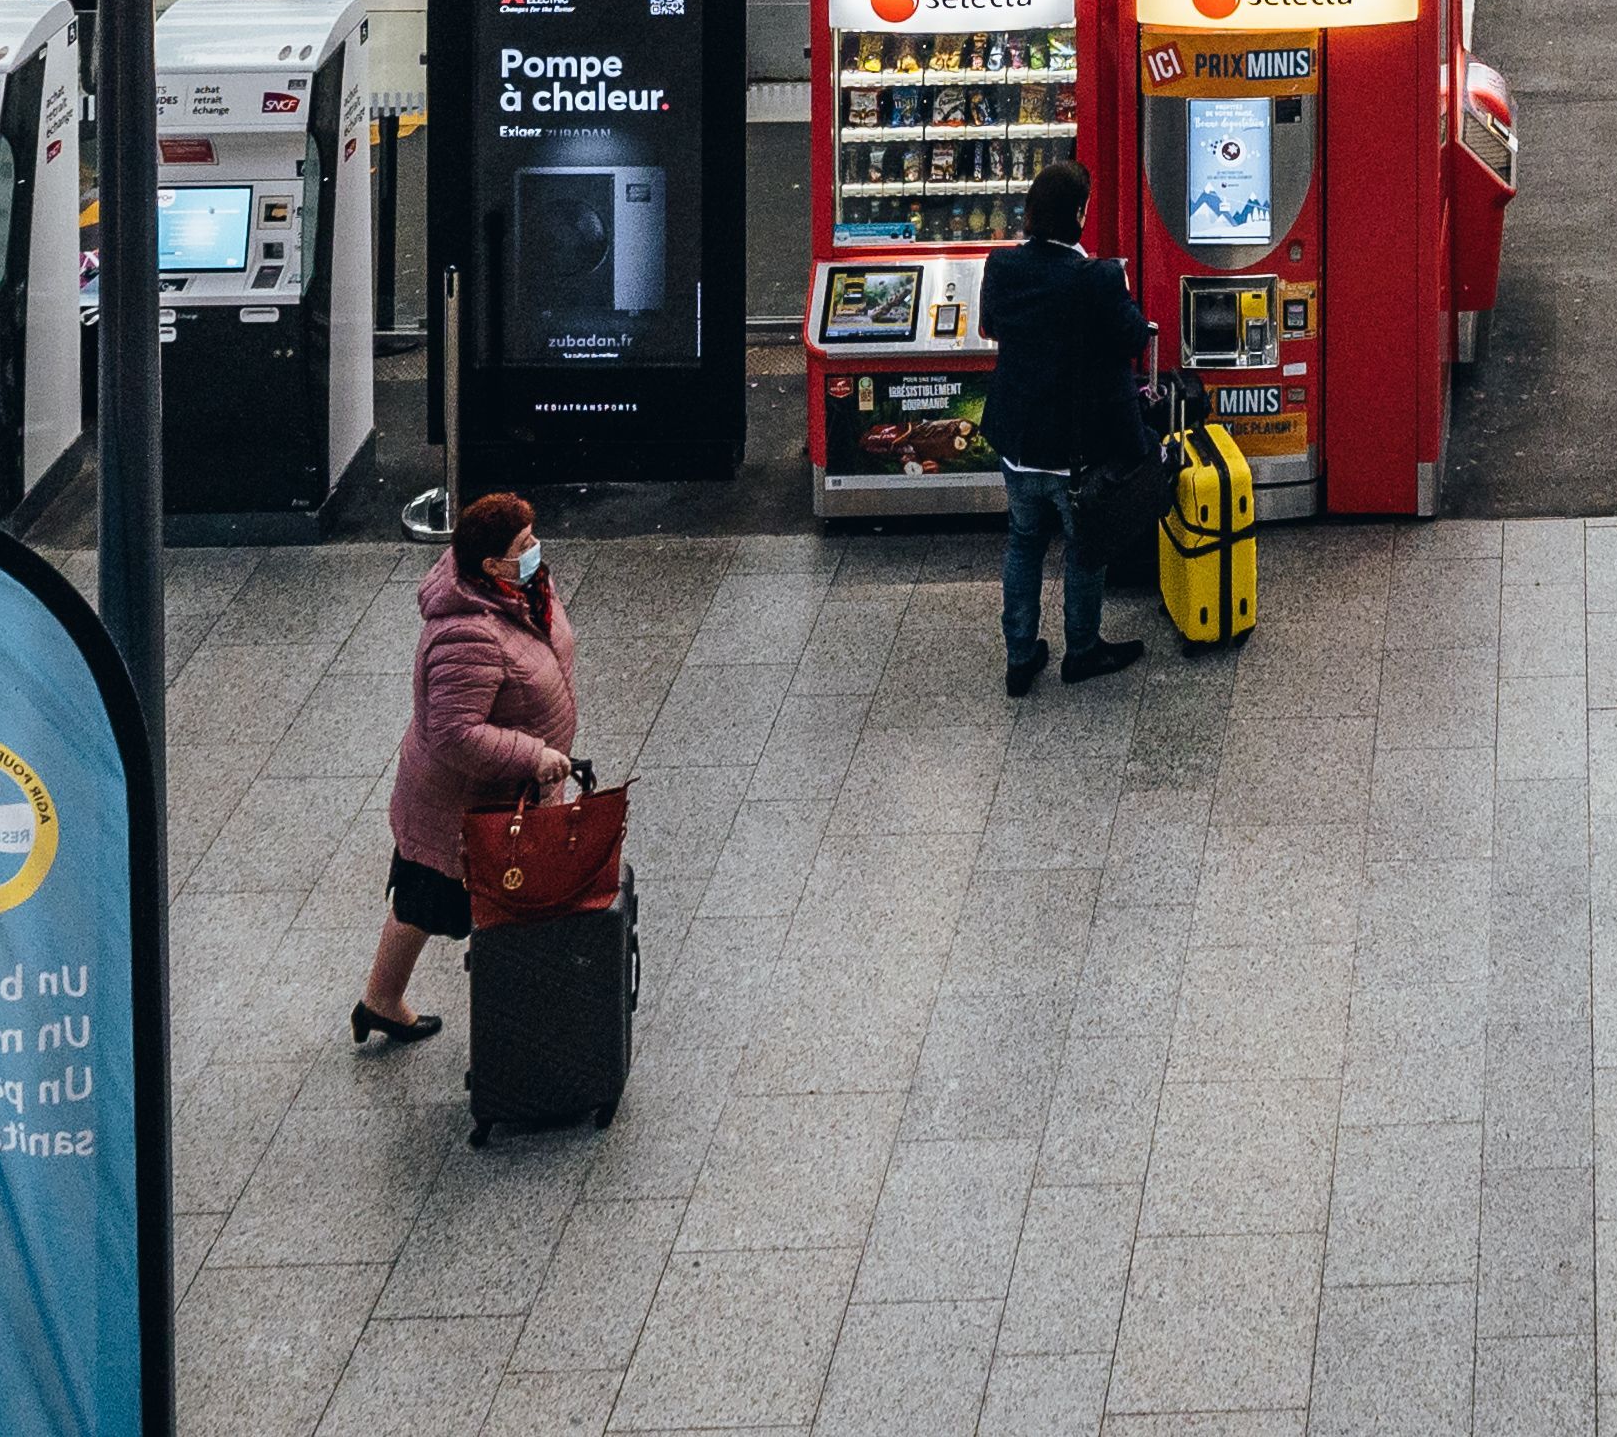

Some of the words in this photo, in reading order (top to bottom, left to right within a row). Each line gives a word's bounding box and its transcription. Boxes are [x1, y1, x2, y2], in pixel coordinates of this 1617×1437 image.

[501, 48, 623, 85] Pompe
[1147, 47, 1183, 82] ICI
[1194, 53, 1244, 78] PRIX
[194, 85, 221, 94] achat
[499, 82, 522, 112] à
[532, 81, 670, 112] chaleur.
[193, 95, 223, 105] retrait
[264, 99, 298, 111] SNCF
[192, 105, 230, 116] échange
[548, 333, 634, 348] zubadan.fr
[535, 403, 638, 412] MEDIATRANSPORTS
[901, 397, 950, 412] GOURMANDE
[1219, 388, 1279, 414] MINIS
